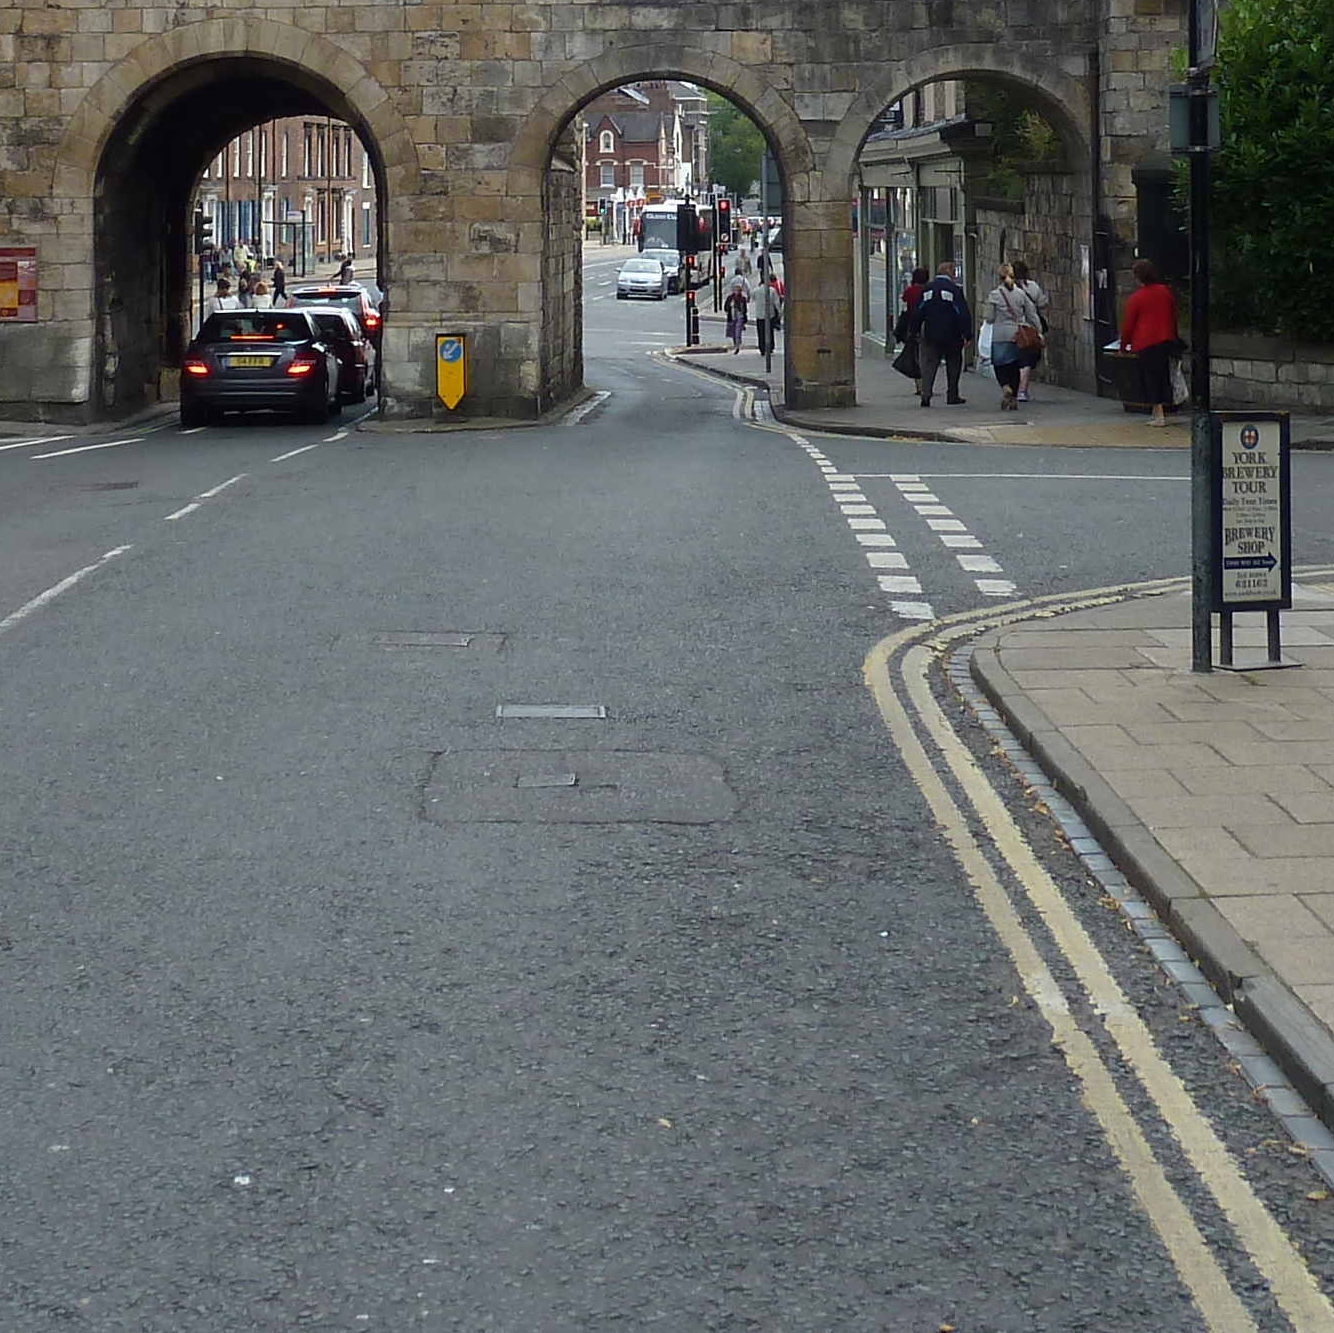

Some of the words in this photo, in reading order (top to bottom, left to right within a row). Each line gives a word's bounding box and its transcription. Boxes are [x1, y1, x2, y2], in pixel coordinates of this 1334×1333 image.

[1232, 452, 1267, 465] YORK
[1223, 466, 1278, 480] BREWERY
[1232, 481, 1267, 495] TOUR
[1224, 526, 1275, 547] BREWERY
[1237, 540, 1265, 555] SHOP
